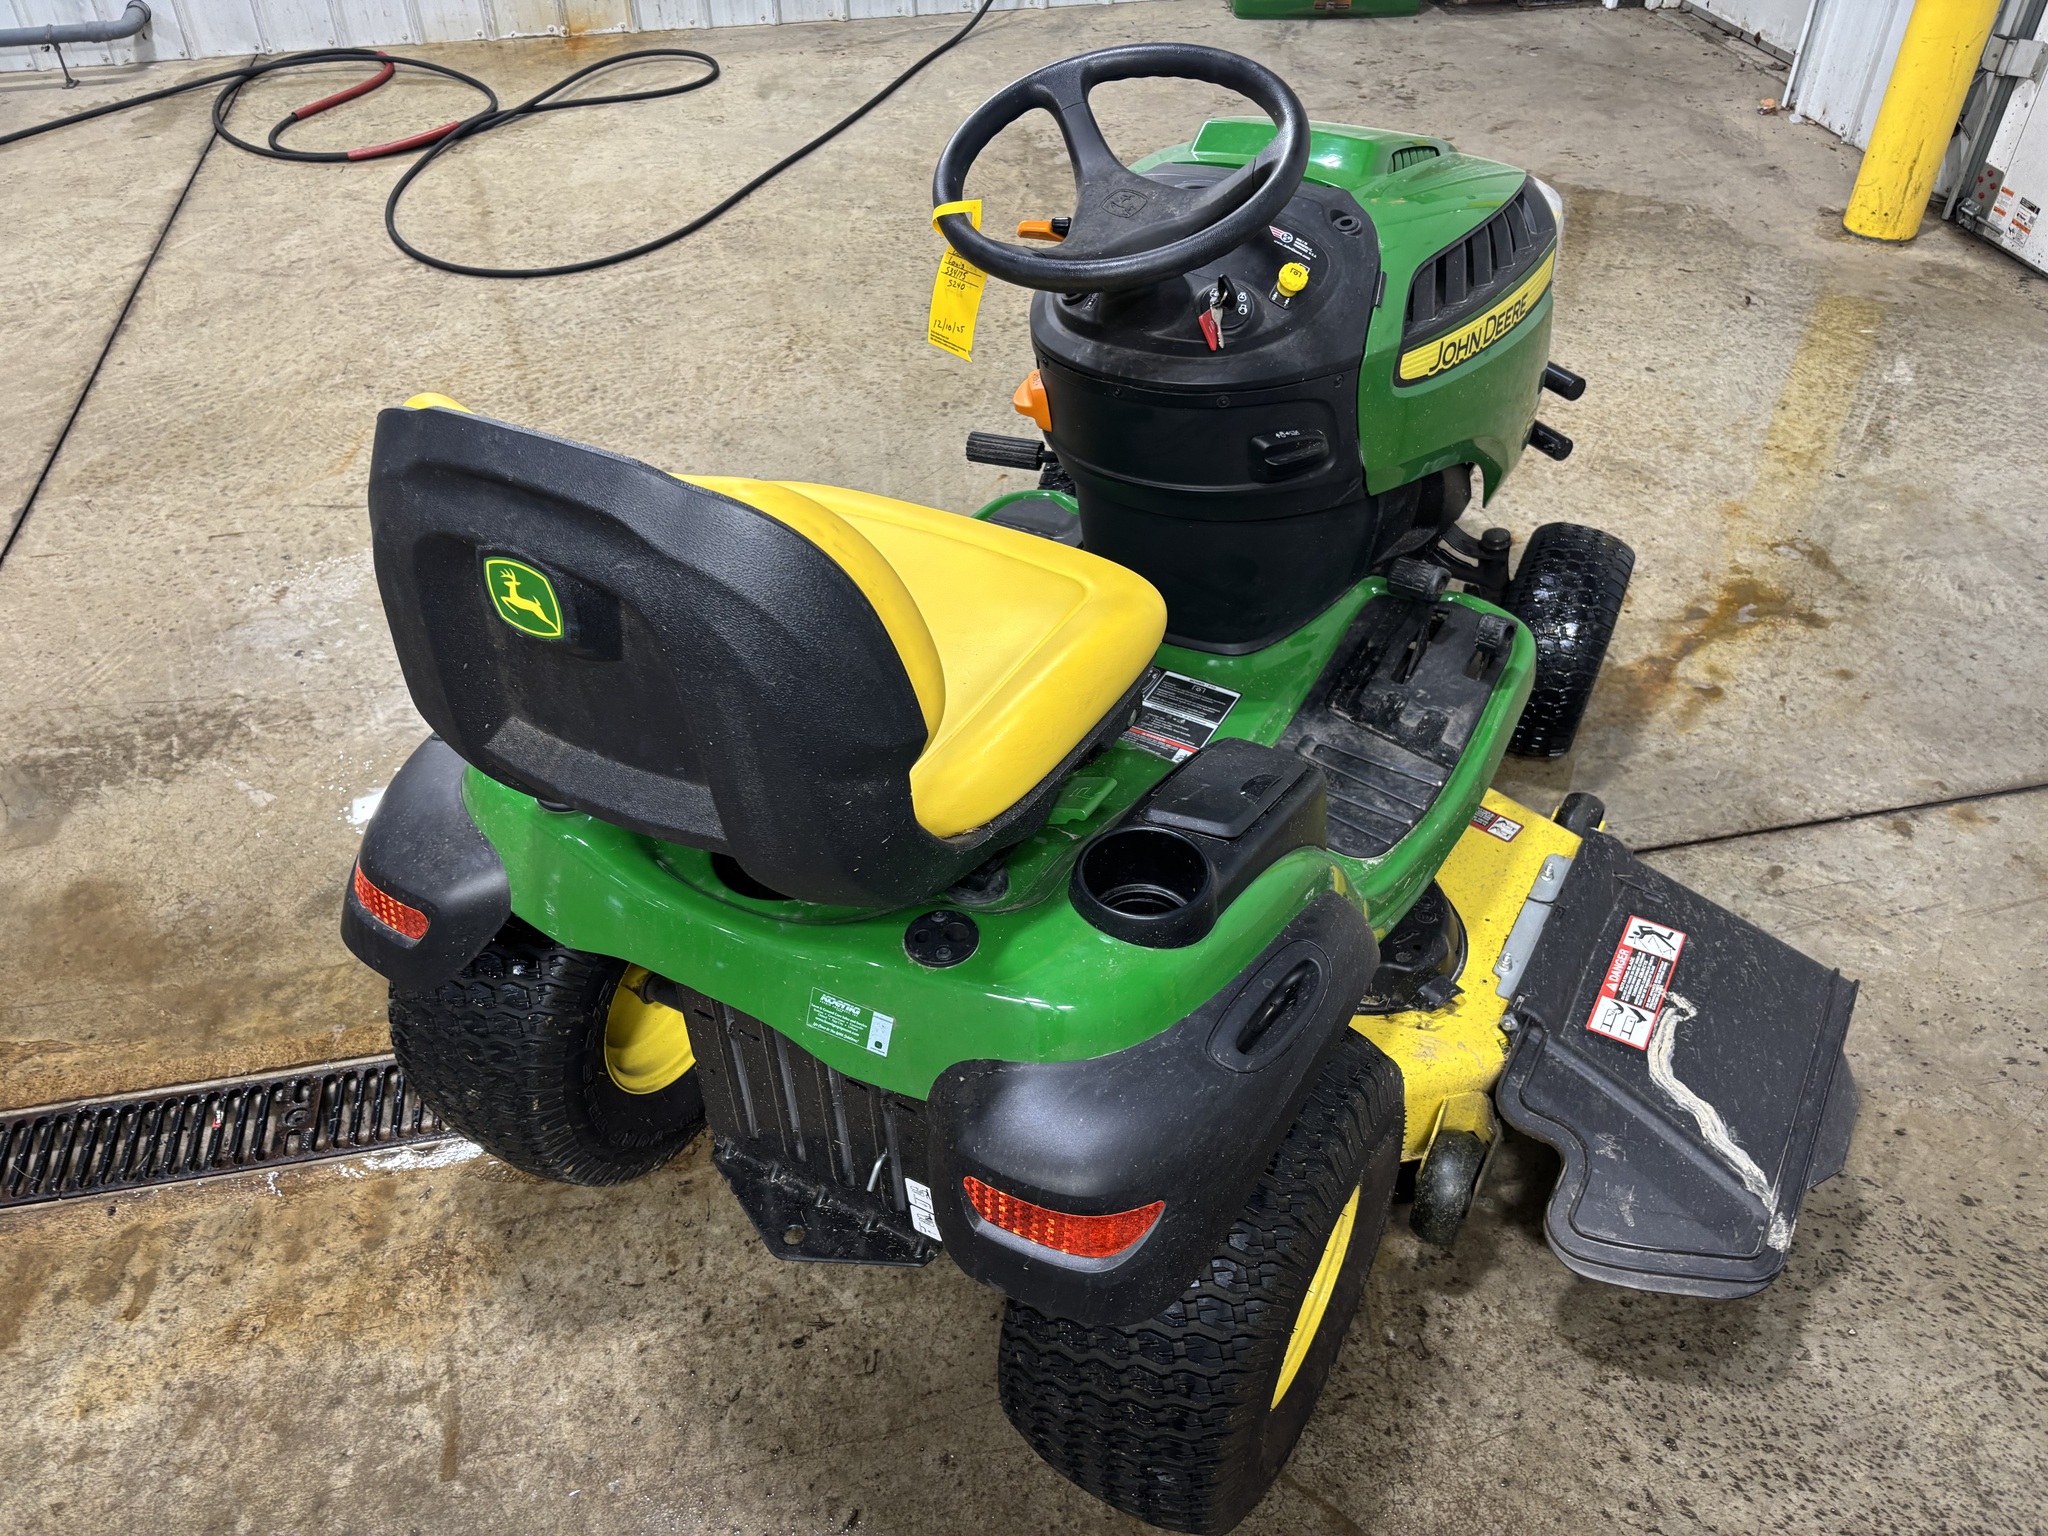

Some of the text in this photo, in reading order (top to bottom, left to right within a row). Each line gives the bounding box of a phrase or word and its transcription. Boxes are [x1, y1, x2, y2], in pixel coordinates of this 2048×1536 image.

[1429, 293, 1529, 373] JOHN DEERE
[1608, 948, 1630, 985] DANGER
